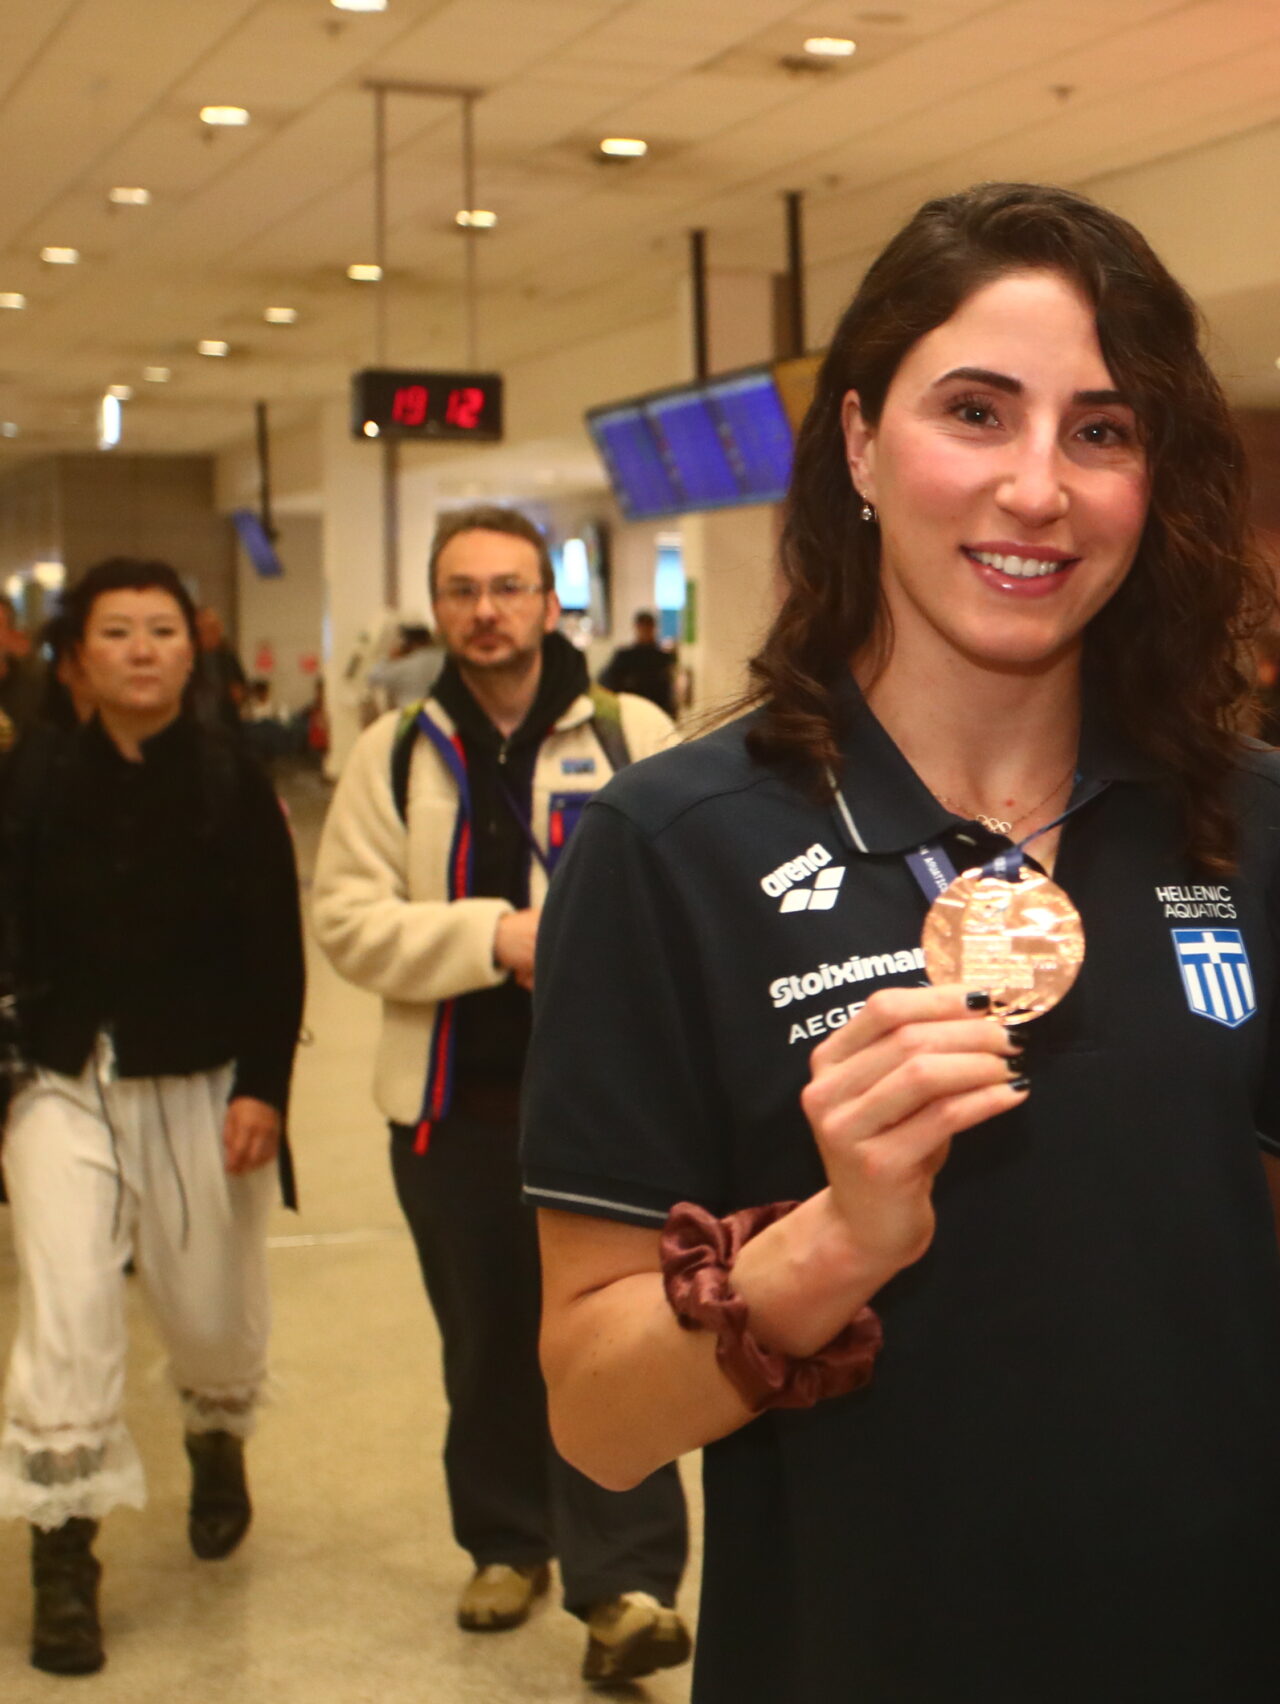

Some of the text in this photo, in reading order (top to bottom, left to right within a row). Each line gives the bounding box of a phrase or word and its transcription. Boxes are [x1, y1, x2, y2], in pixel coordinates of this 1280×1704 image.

[760, 843, 833, 898] arena
[923, 857, 948, 894] AQUATIC
[1154, 885, 1232, 902] HELLENIC
[1164, 902, 1237, 919] AQUATICS
[789, 1001, 867, 1044] AEGE
